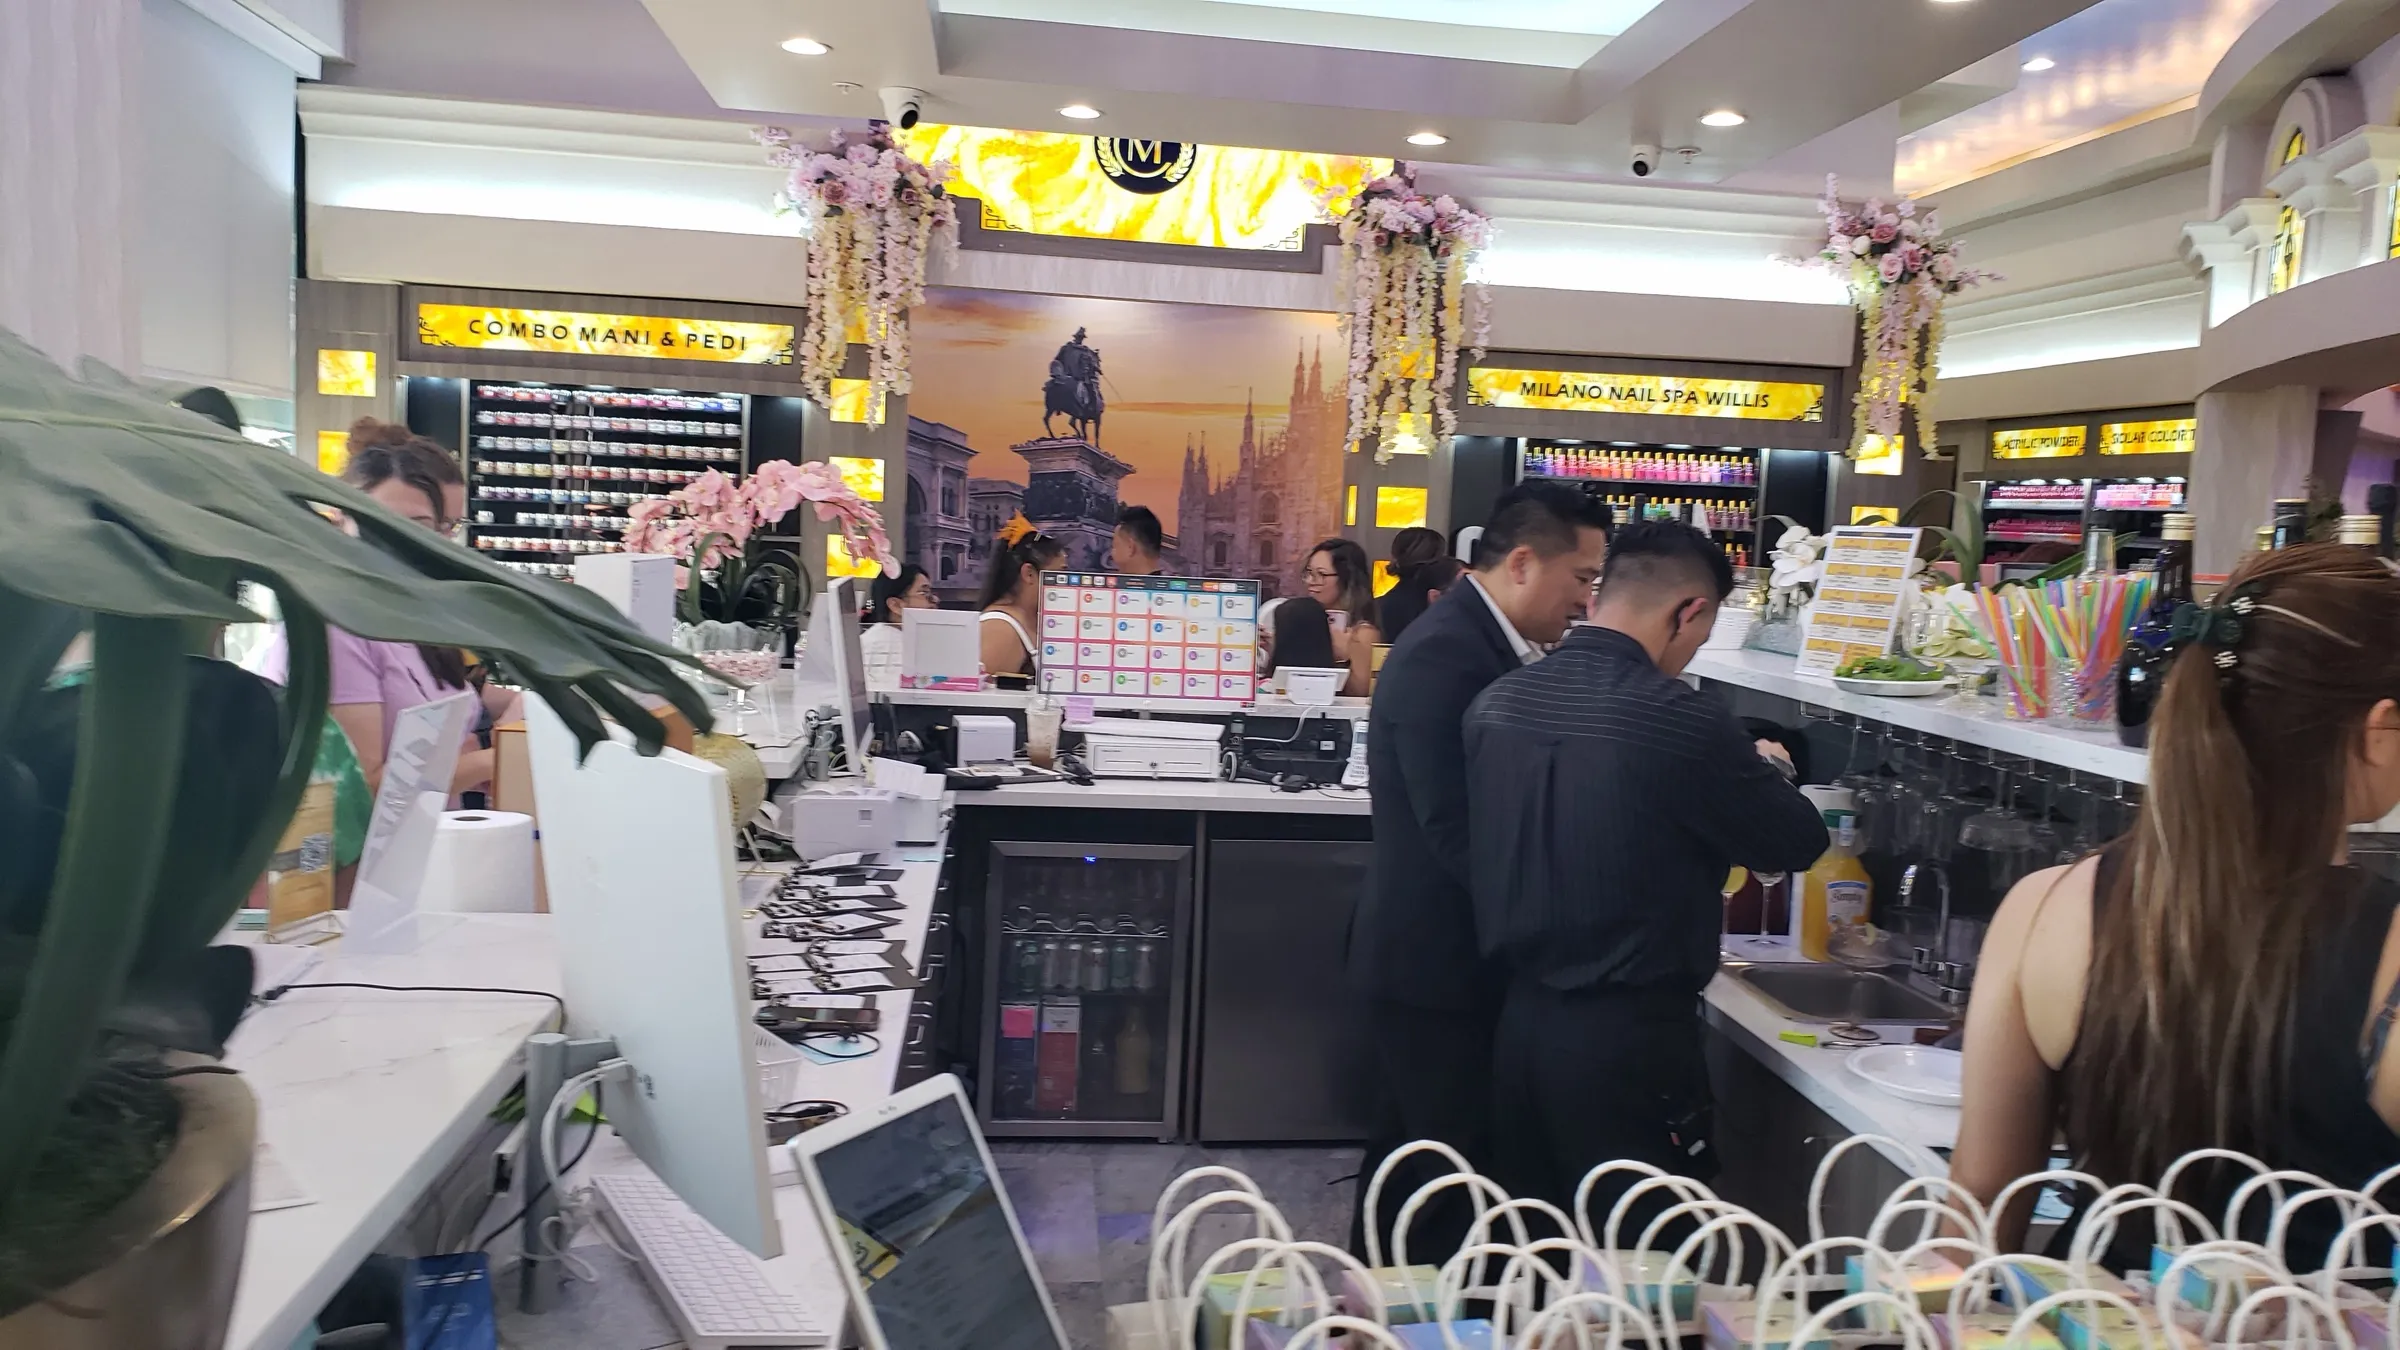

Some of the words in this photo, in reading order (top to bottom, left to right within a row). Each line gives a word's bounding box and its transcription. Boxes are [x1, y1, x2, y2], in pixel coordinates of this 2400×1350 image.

[1127, 138, 1162, 164] M
[469, 319, 568, 340] COMBO
[579, 326, 650, 346] MANI
[661, 331, 676, 347] &
[686, 332, 746, 351] PEDI
[1520, 382, 1602, 399] MILANO
[1609, 386, 1656, 402] NAIL
[1663, 389, 1699, 405] SPA
[1705, 391, 1770, 408] WILLIS
[2039, 435, 2080, 448] POWDER
[2112, 431, 2146, 444] SOLAR
[2148, 429, 2187, 442] COLOR
